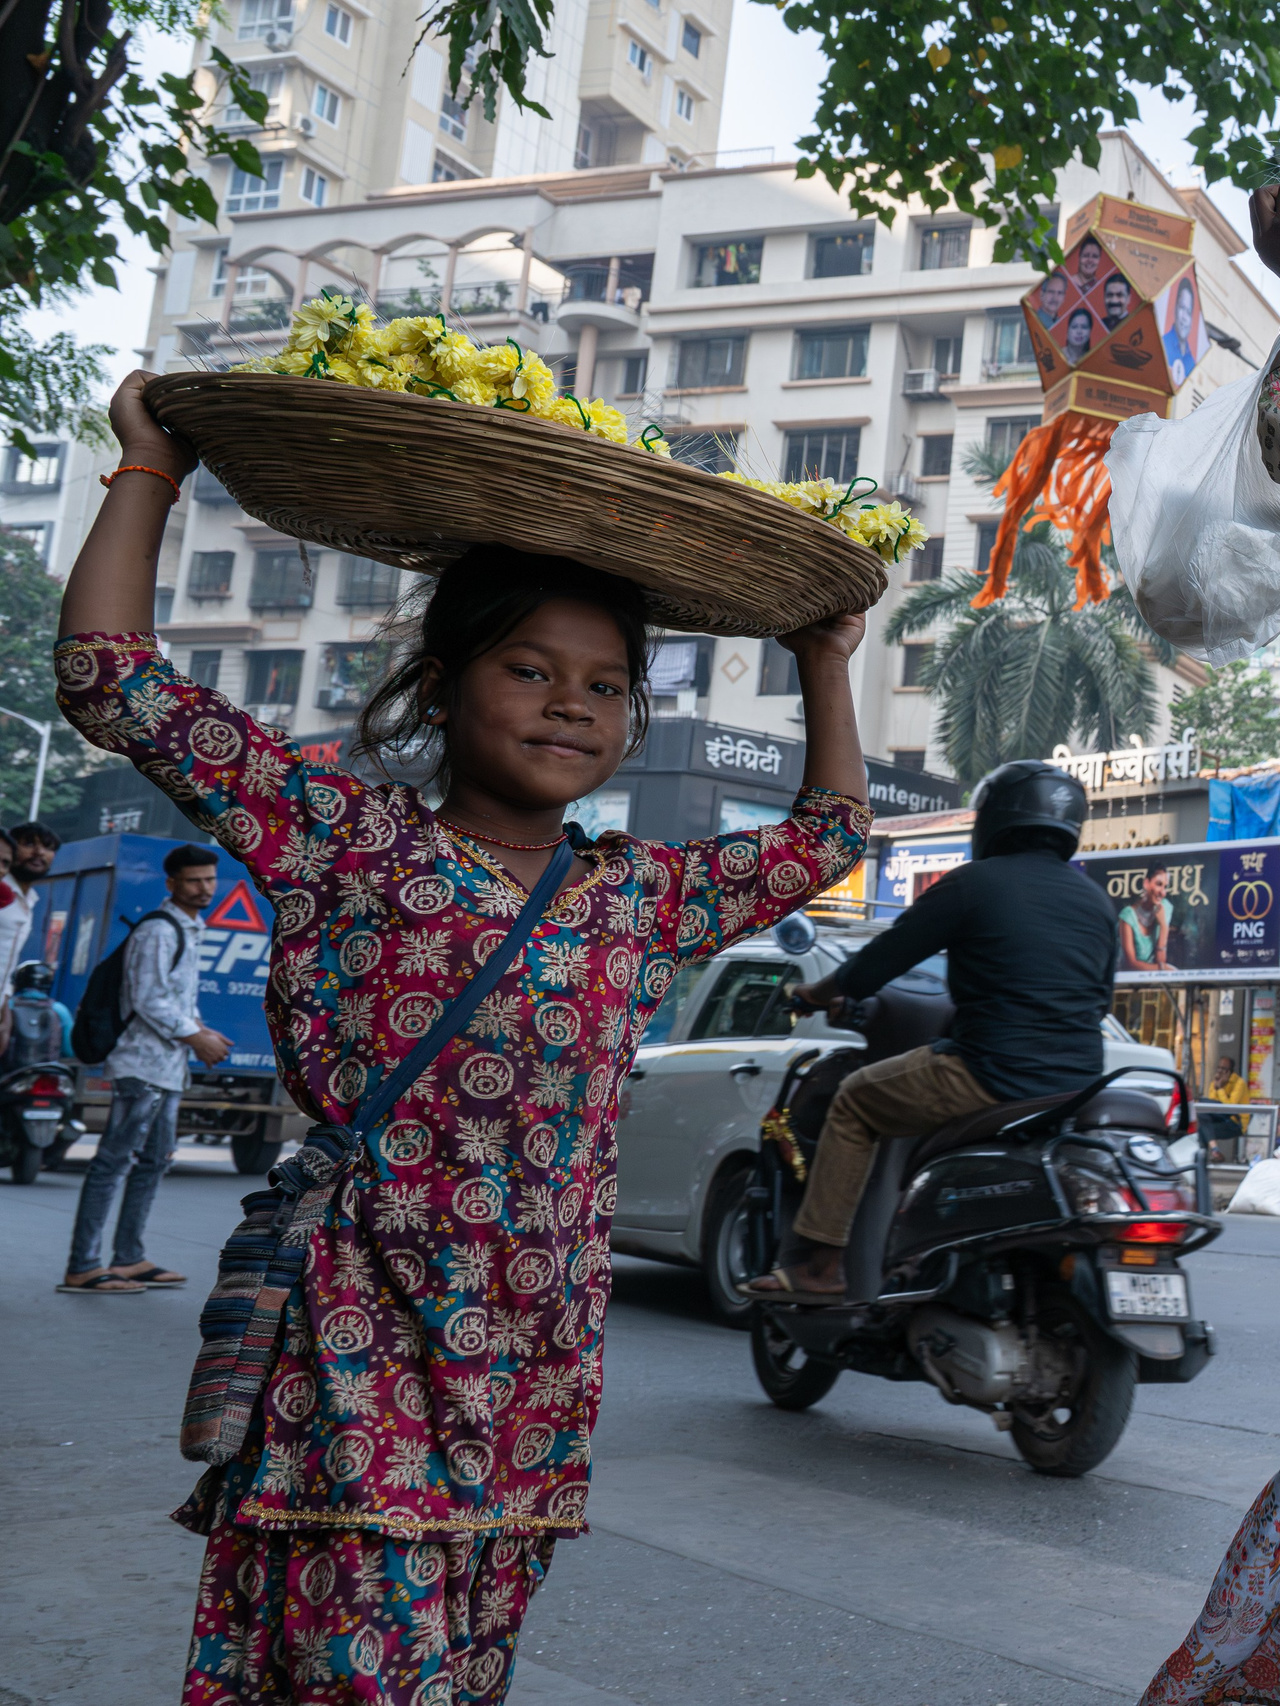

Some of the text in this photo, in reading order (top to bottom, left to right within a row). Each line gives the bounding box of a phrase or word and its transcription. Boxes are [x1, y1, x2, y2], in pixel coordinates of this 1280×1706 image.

[704, 734, 783, 775] इंटेग्रिटी
[1108, 727, 1196, 784] ज्वेलर्स
[1233, 921, 1265, 939] PNG
[1129, 1275, 1173, 1294] MH01
